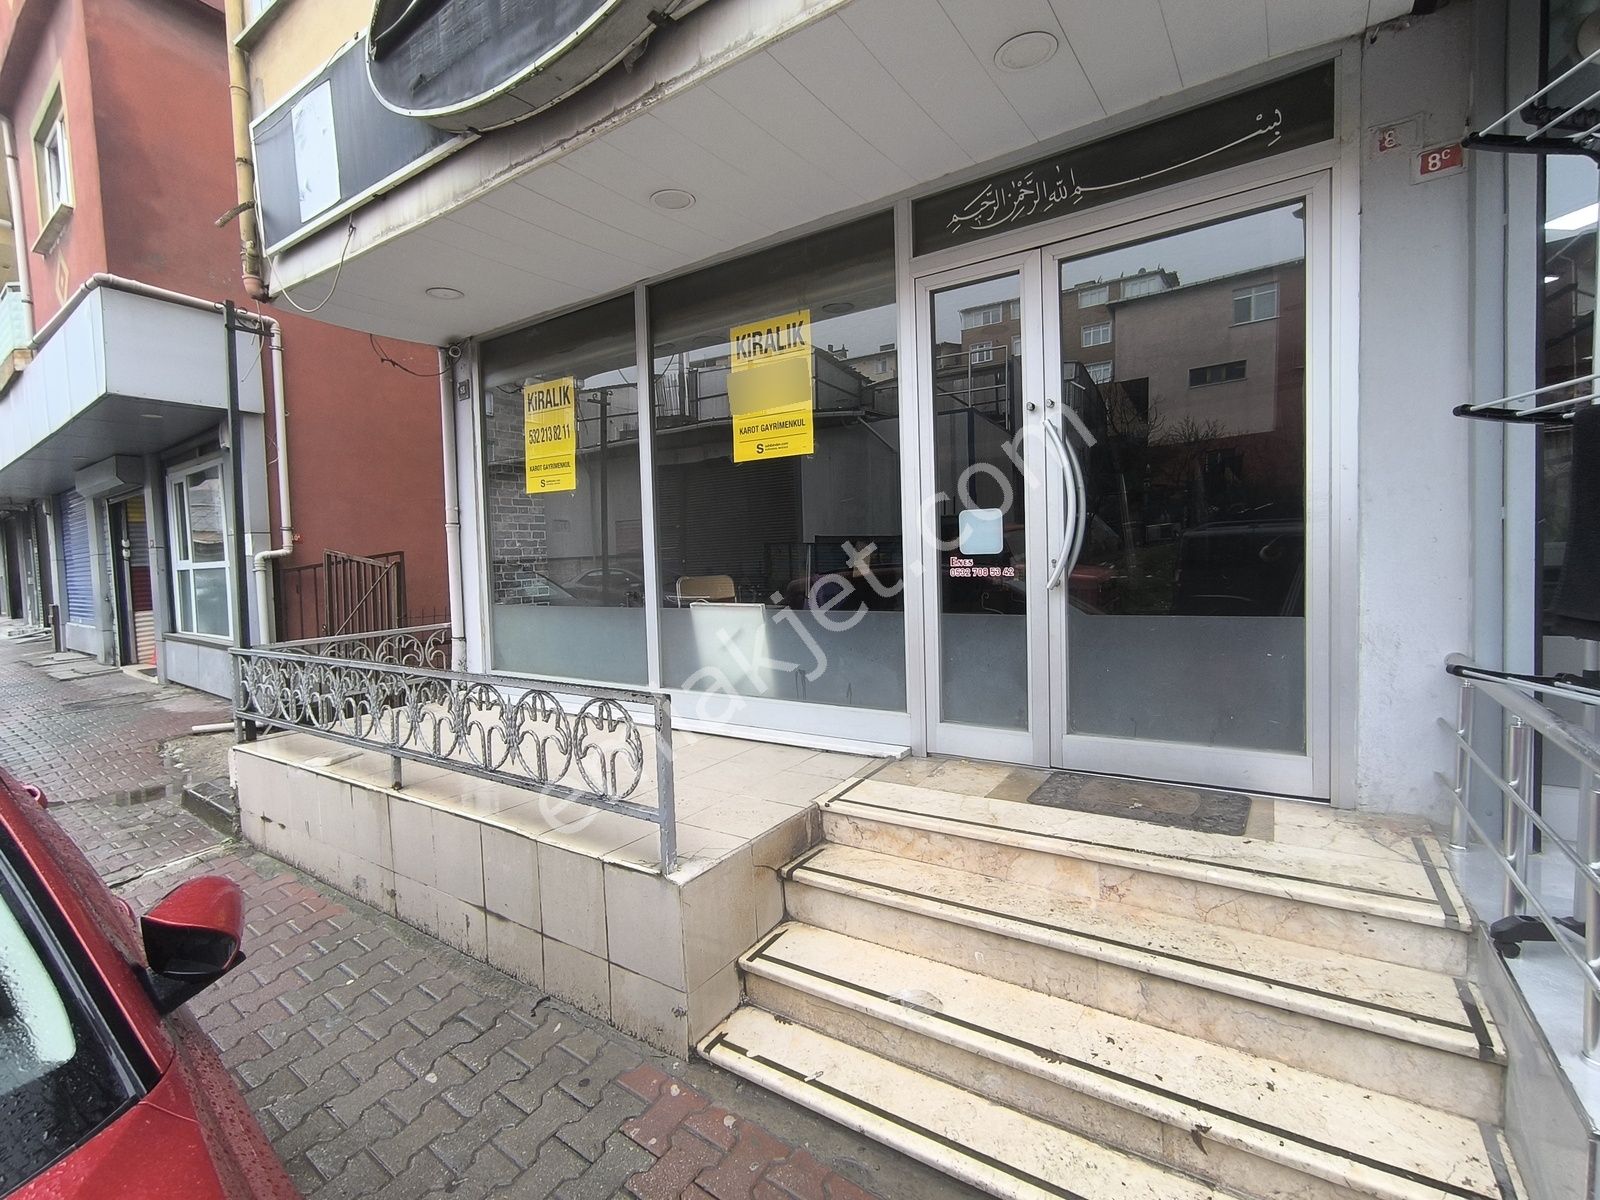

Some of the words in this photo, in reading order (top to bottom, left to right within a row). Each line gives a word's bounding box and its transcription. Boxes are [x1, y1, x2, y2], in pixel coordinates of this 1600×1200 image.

[529, 427, 541, 445] 532
[541, 425, 552, 443] 213
[553, 425, 561, 441] 82
[562, 423, 571, 439] 11
[739, 425, 760, 435] KAROT
